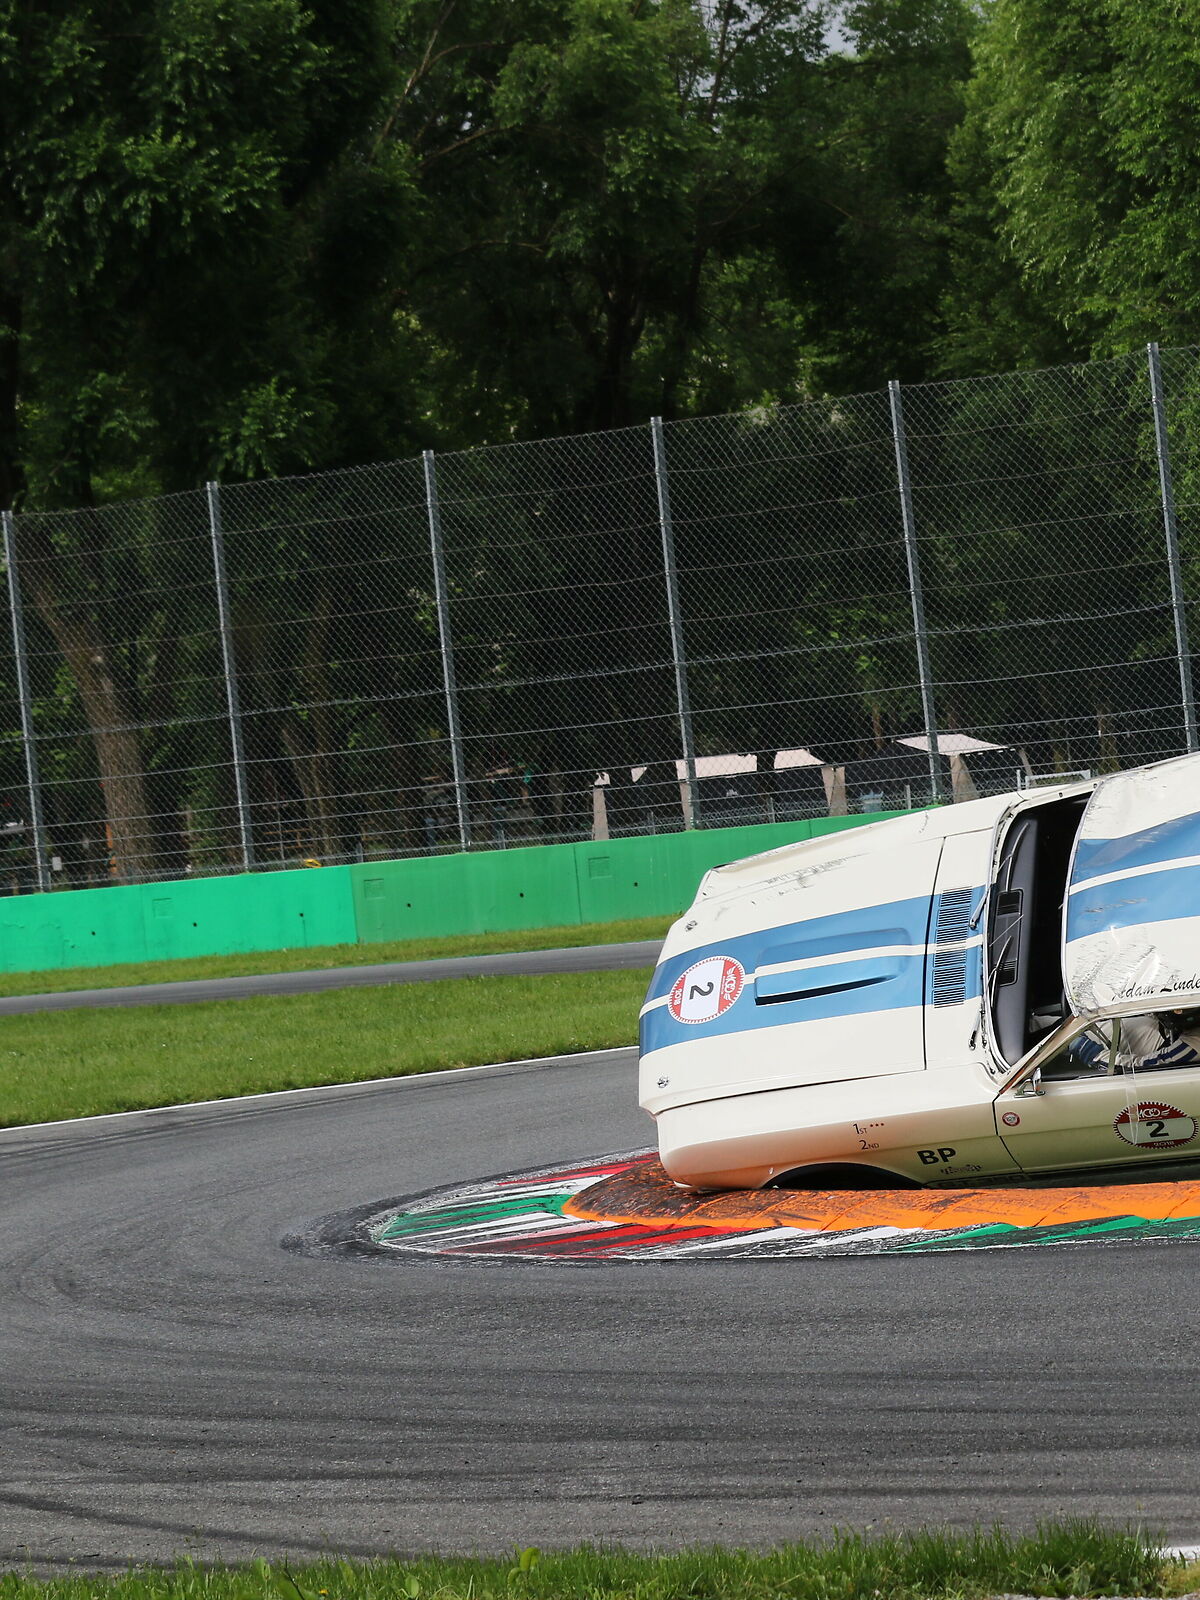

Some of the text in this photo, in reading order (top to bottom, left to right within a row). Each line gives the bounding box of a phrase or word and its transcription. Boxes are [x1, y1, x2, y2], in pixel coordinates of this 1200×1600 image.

[689, 981, 714, 1000] 2
[1146, 1120, 1170, 1138] 2
[916, 1147, 957, 1166] BP
